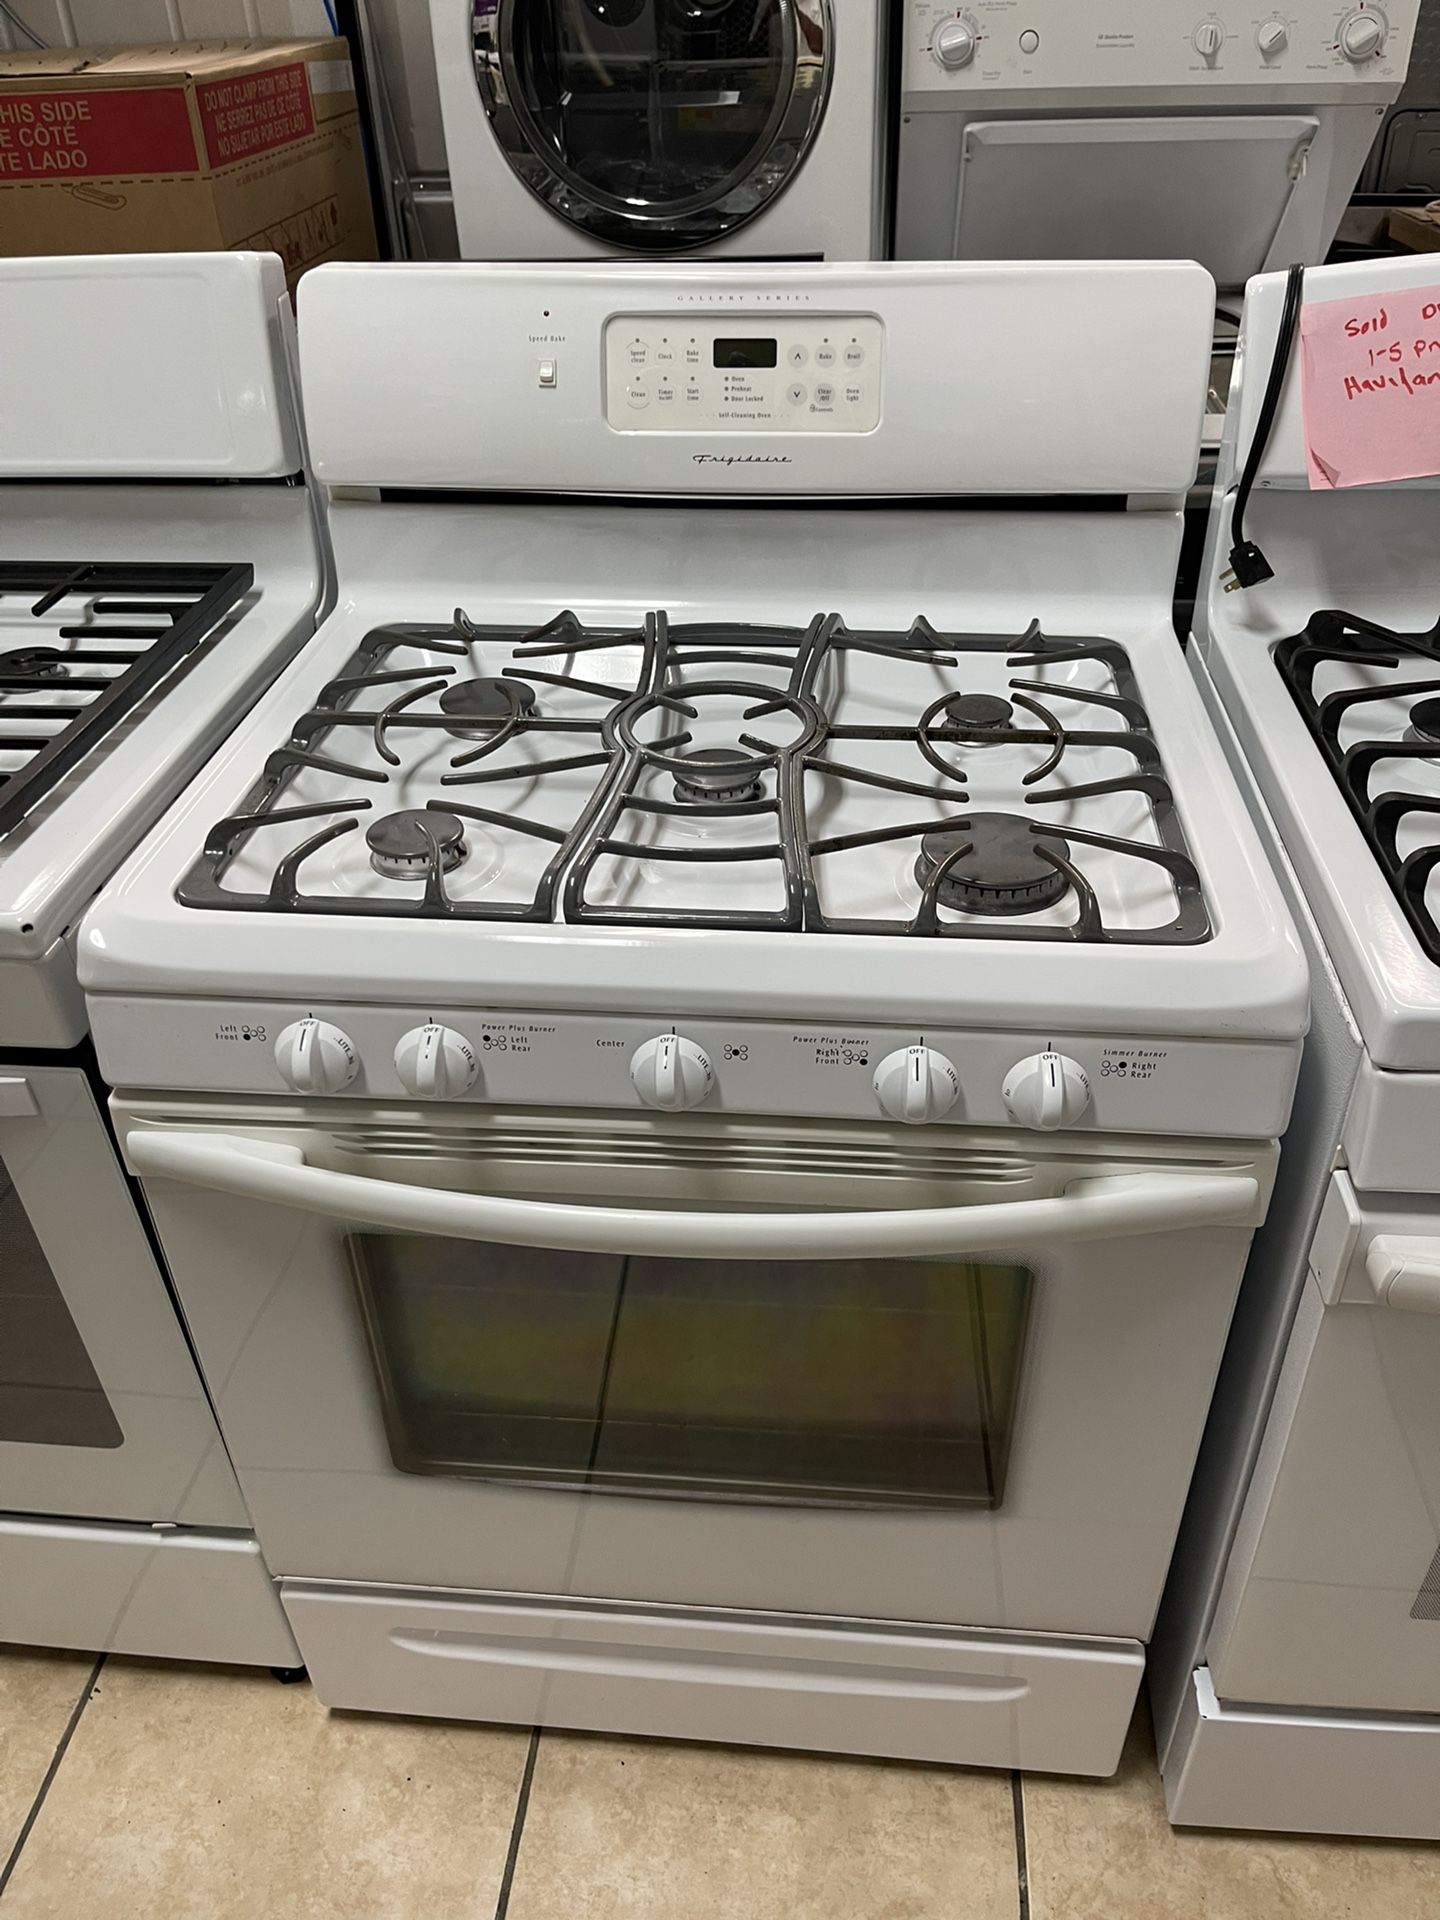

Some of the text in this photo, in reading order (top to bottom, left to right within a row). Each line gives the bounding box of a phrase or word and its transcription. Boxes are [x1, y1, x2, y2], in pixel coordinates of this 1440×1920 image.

[203, 90, 217, 111] DO
[216, 86, 233, 108] NOT
[232, 80, 257, 104] CLAMP
[40, 100, 92, 122] SIDE
[19, 121, 79, 147] CÔTÉ
[217, 136, 230, 158] NO
[27, 149, 87, 170] LADO
[1344, 308, 1387, 337] Sold
[1369, 341, 1402, 366] 1-5
[692, 454, 792, 466] Frigidaire
[220, 1025, 237, 1033] Left
[482, 1023, 505, 1031] Power
[215, 1033, 238, 1041] Front
[596, 1039, 625, 1047] Center
[512, 1044, 531, 1052] Rear
[816, 1048, 839, 1057] Right
[1103, 1049, 1168, 1058] Simmer Burner
[815, 1056, 839, 1065] Front
[1132, 1062, 1157, 1070] Right
[1130, 1070, 1152, 1079] Rear
